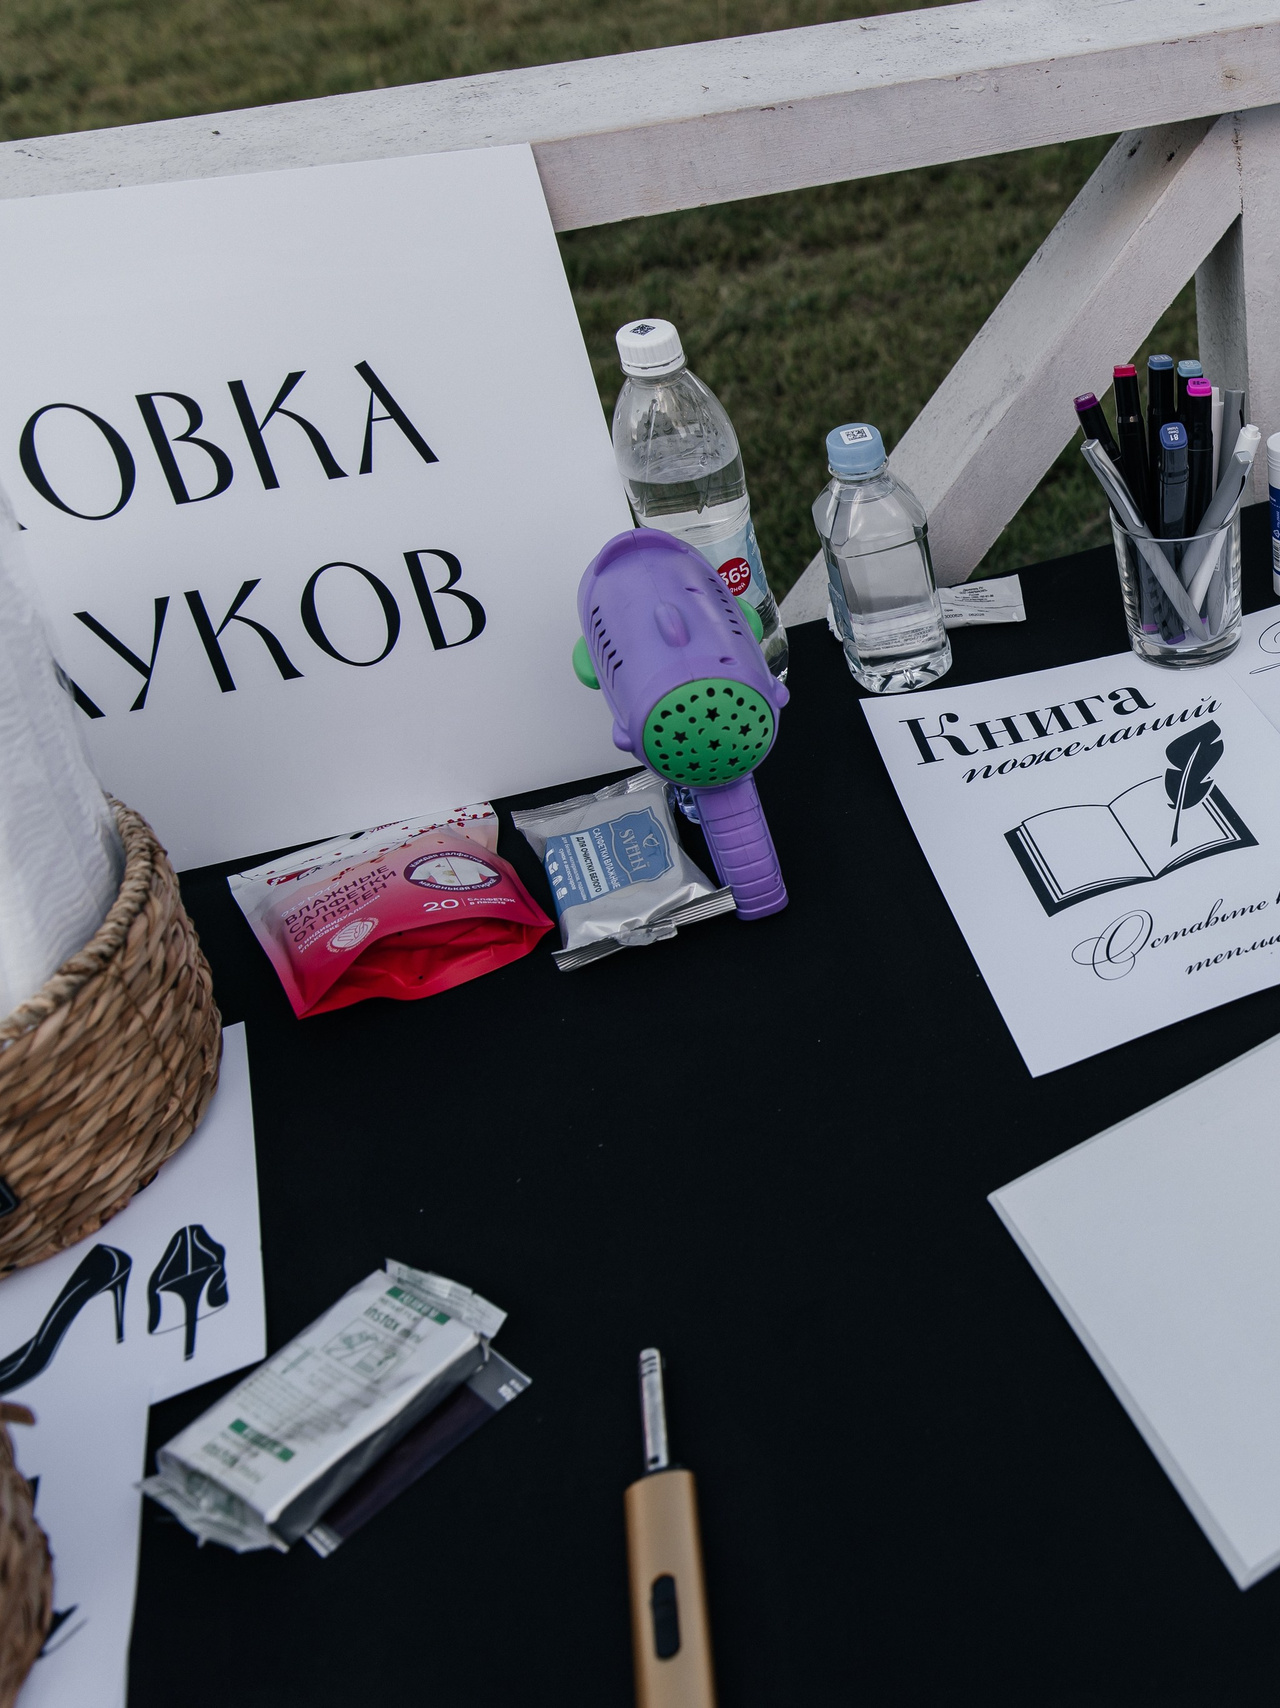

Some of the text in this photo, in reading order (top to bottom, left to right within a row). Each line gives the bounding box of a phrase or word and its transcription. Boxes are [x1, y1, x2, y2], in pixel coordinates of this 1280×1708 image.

[18, 360, 440, 531] ОВКА
[898, 686, 1156, 766] Книга
[962, 696, 1222, 783] пожеланий
[285, 865, 389, 926] ВЛАЖНЫЕ
[290, 870, 397, 934] САЛФЕТКИ
[294, 921, 316, 942] ОТ
[322, 883, 387, 922] ПЯТЕН
[423, 899, 459, 912] 20
[589, 872, 602, 893] БЕЛОГО
[1072, 899, 1268, 980] Оставьте
[363, 1305, 399, 1332] instax
